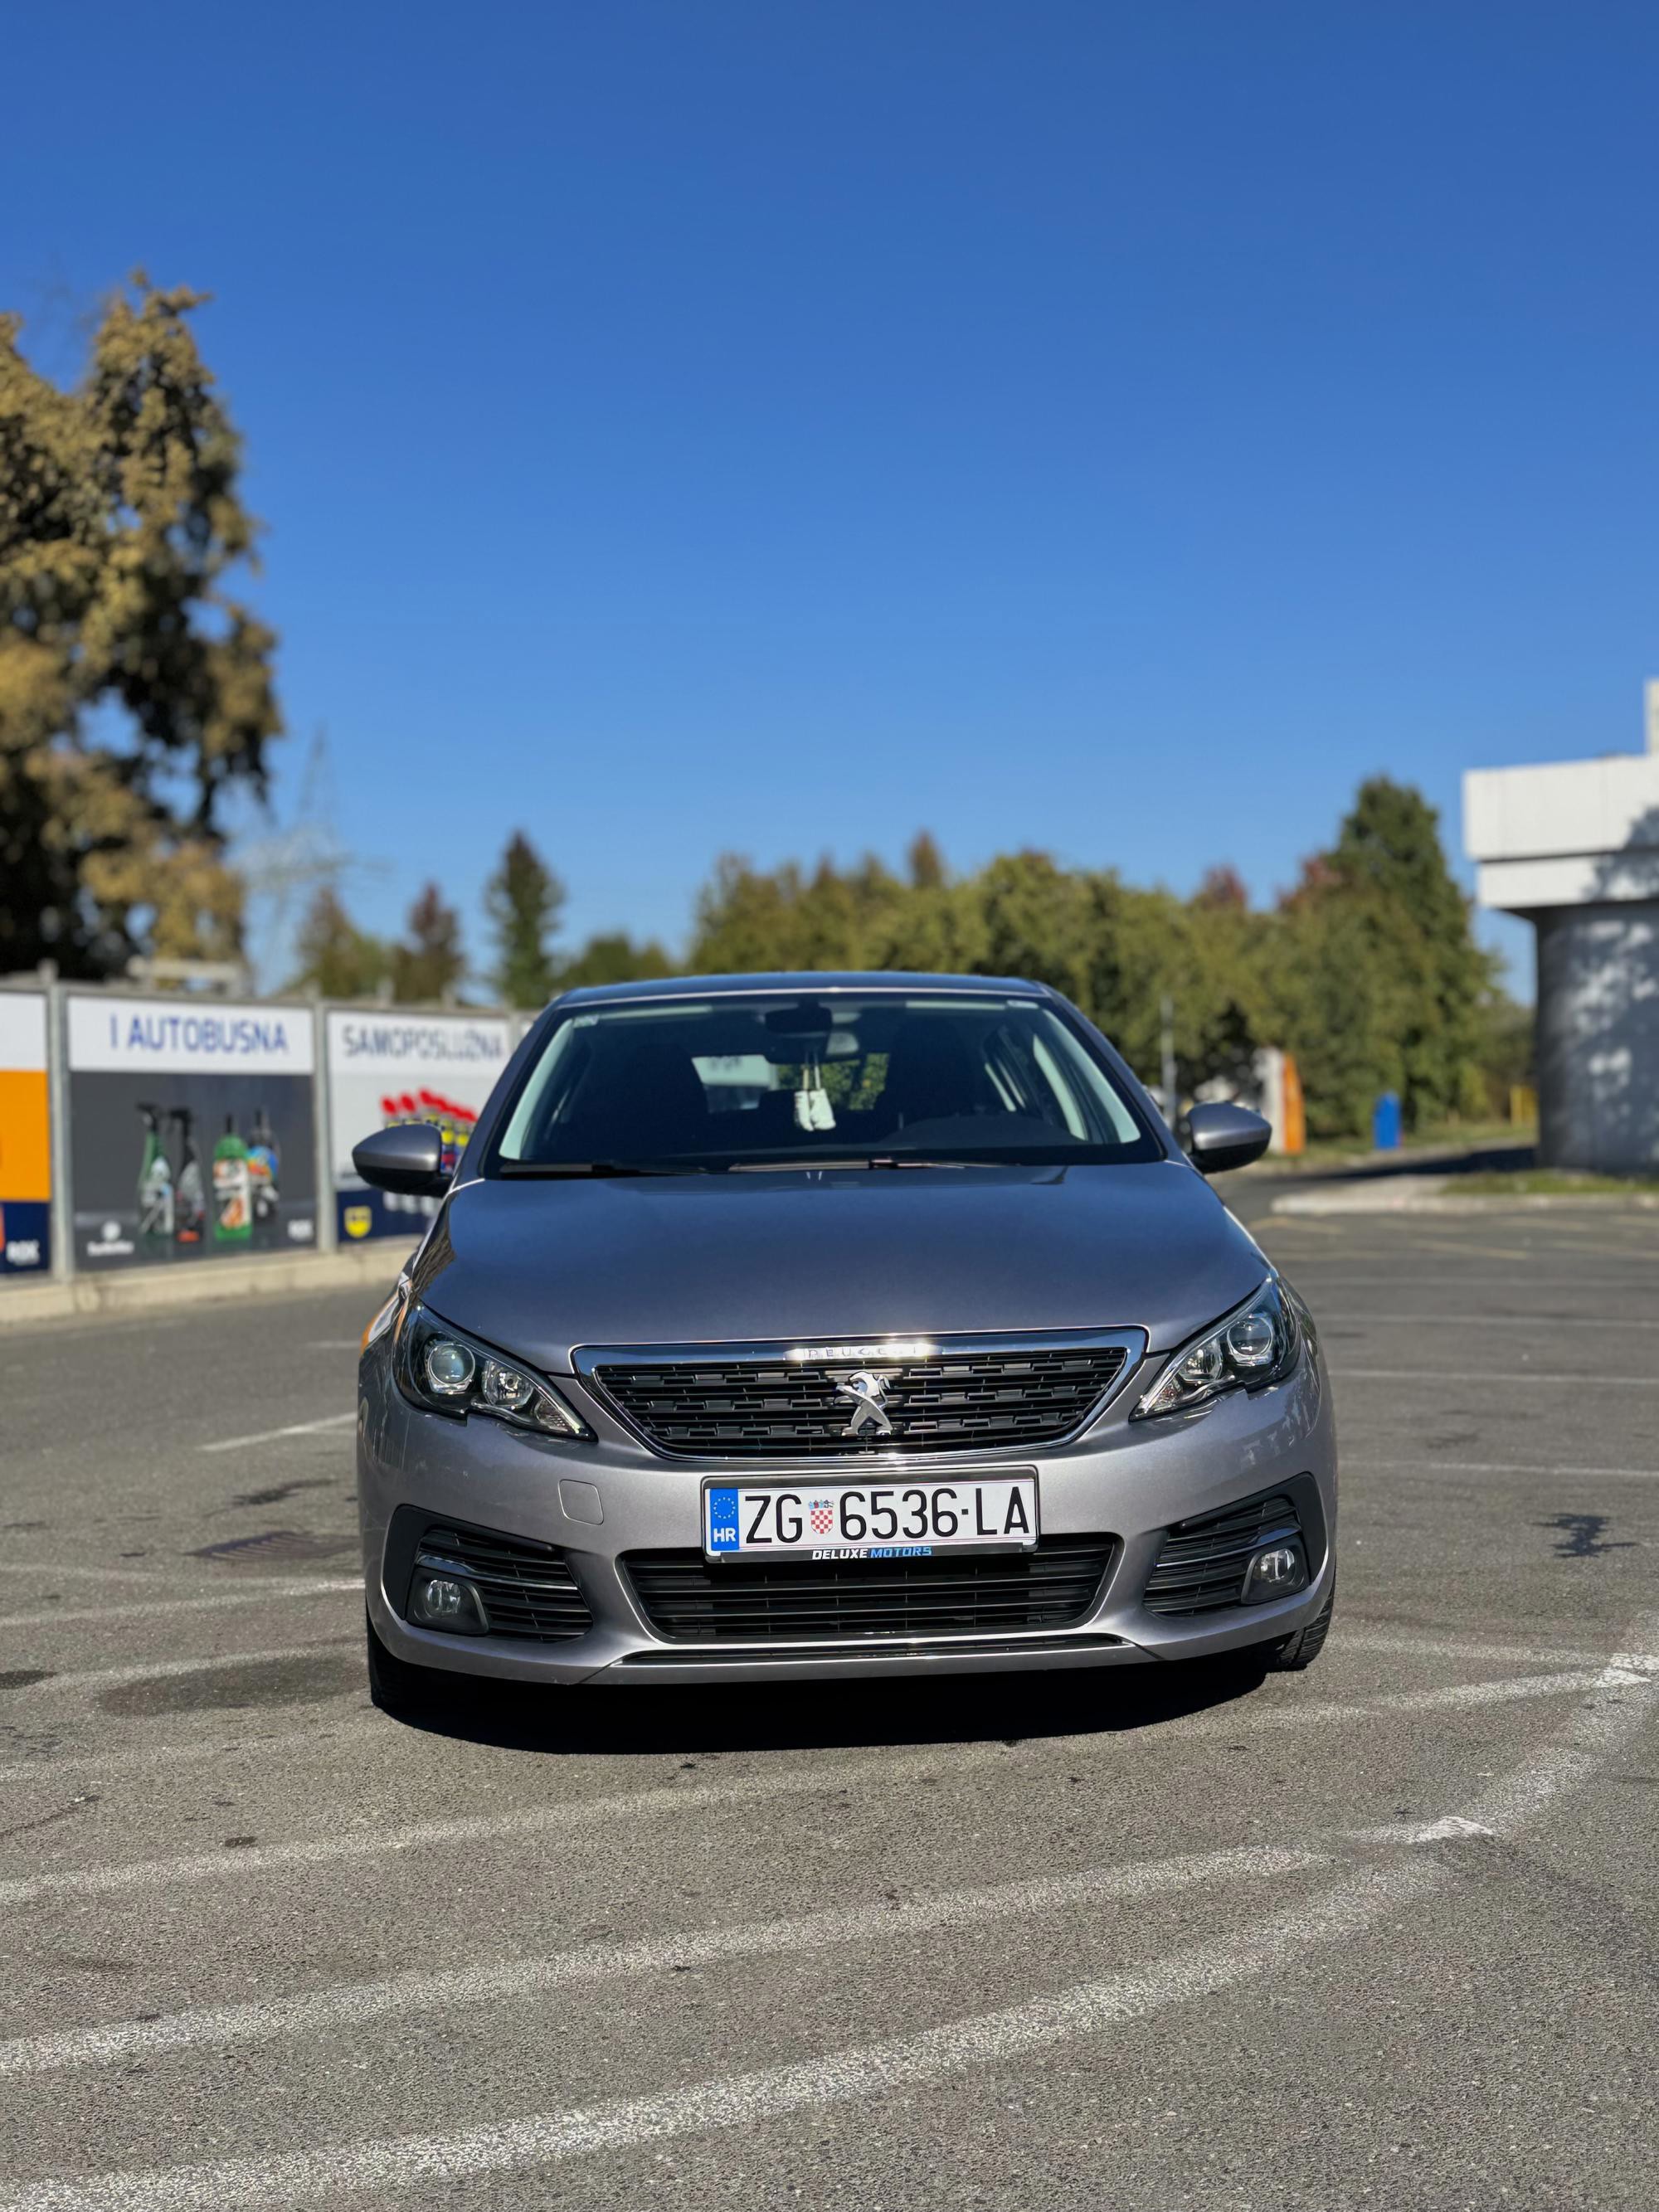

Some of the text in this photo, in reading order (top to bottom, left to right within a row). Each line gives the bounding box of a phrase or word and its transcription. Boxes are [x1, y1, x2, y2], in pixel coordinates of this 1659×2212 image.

[109, 1014, 290, 1055] I AUTOBUSNA
[745, 1494, 802, 1544] ZG
[713, 1527, 736, 1543] HR
[812, 1546, 932, 1560] DELUXE MOTORS
